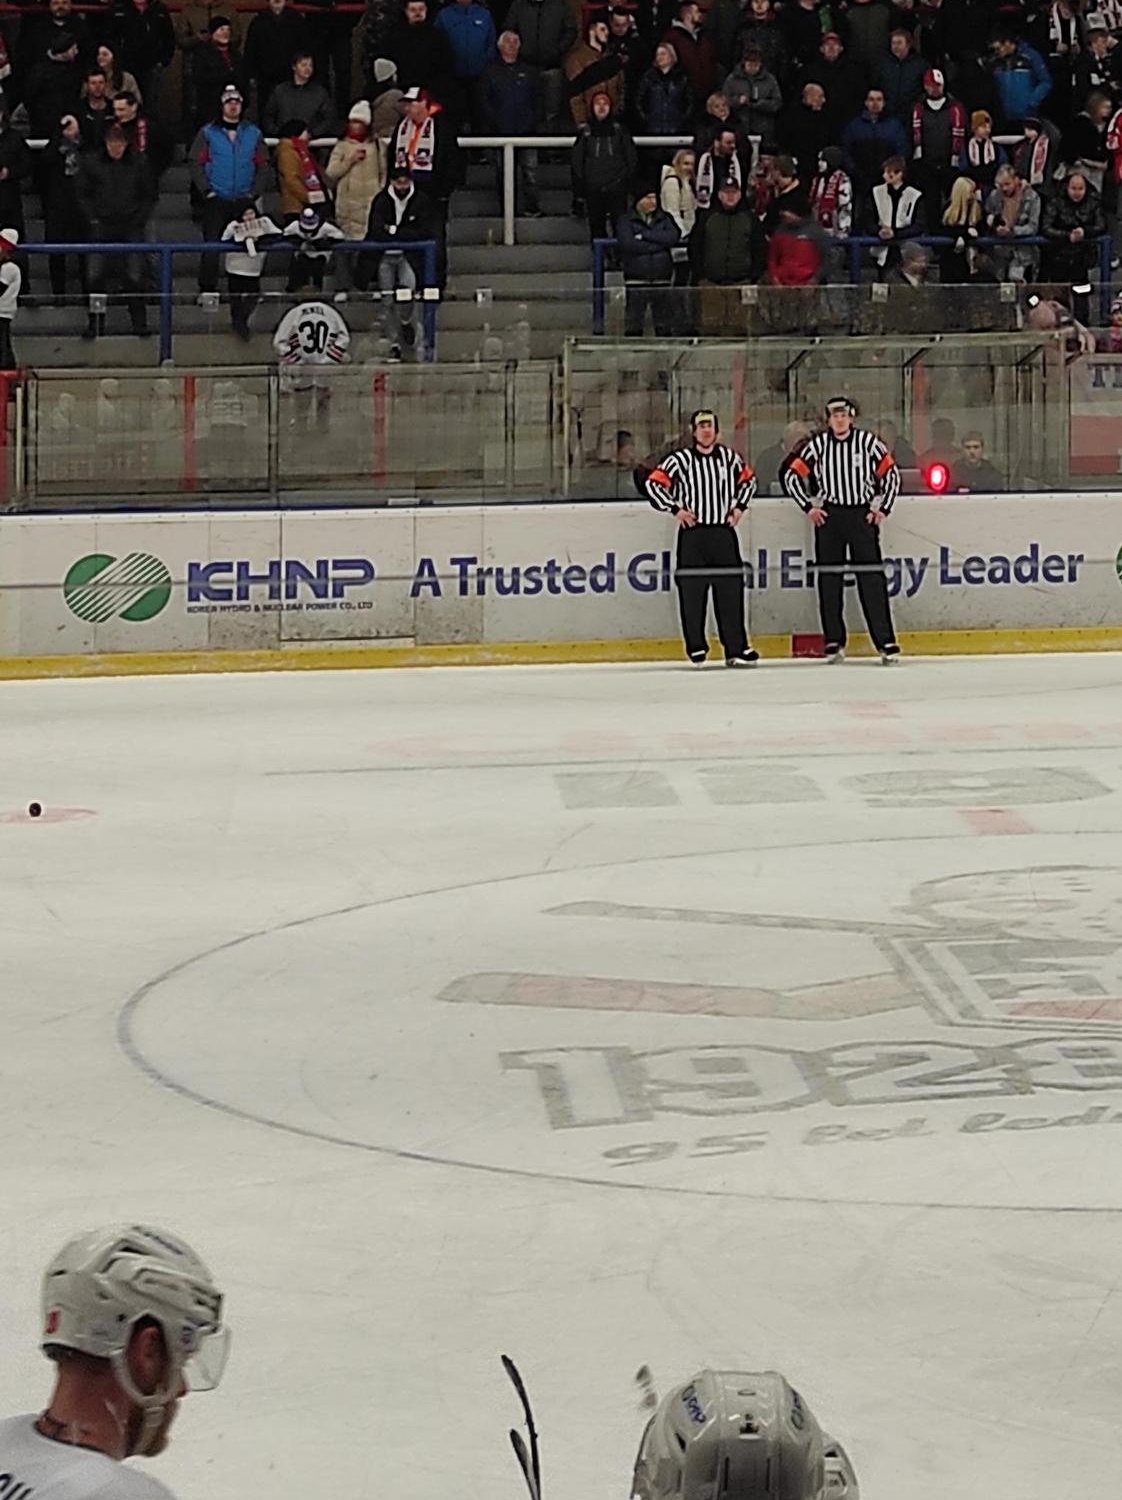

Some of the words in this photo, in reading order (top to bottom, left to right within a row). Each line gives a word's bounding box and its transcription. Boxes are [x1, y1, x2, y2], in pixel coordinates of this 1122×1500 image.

[299, 320, 329, 354] 30
[187, 558, 376, 602] KHNP
[410, 558, 442, 598] A
[450, 552, 615, 597] Trusted
[940, 543, 1085, 586] Leader
[358, 601, 374, 610] LTD
